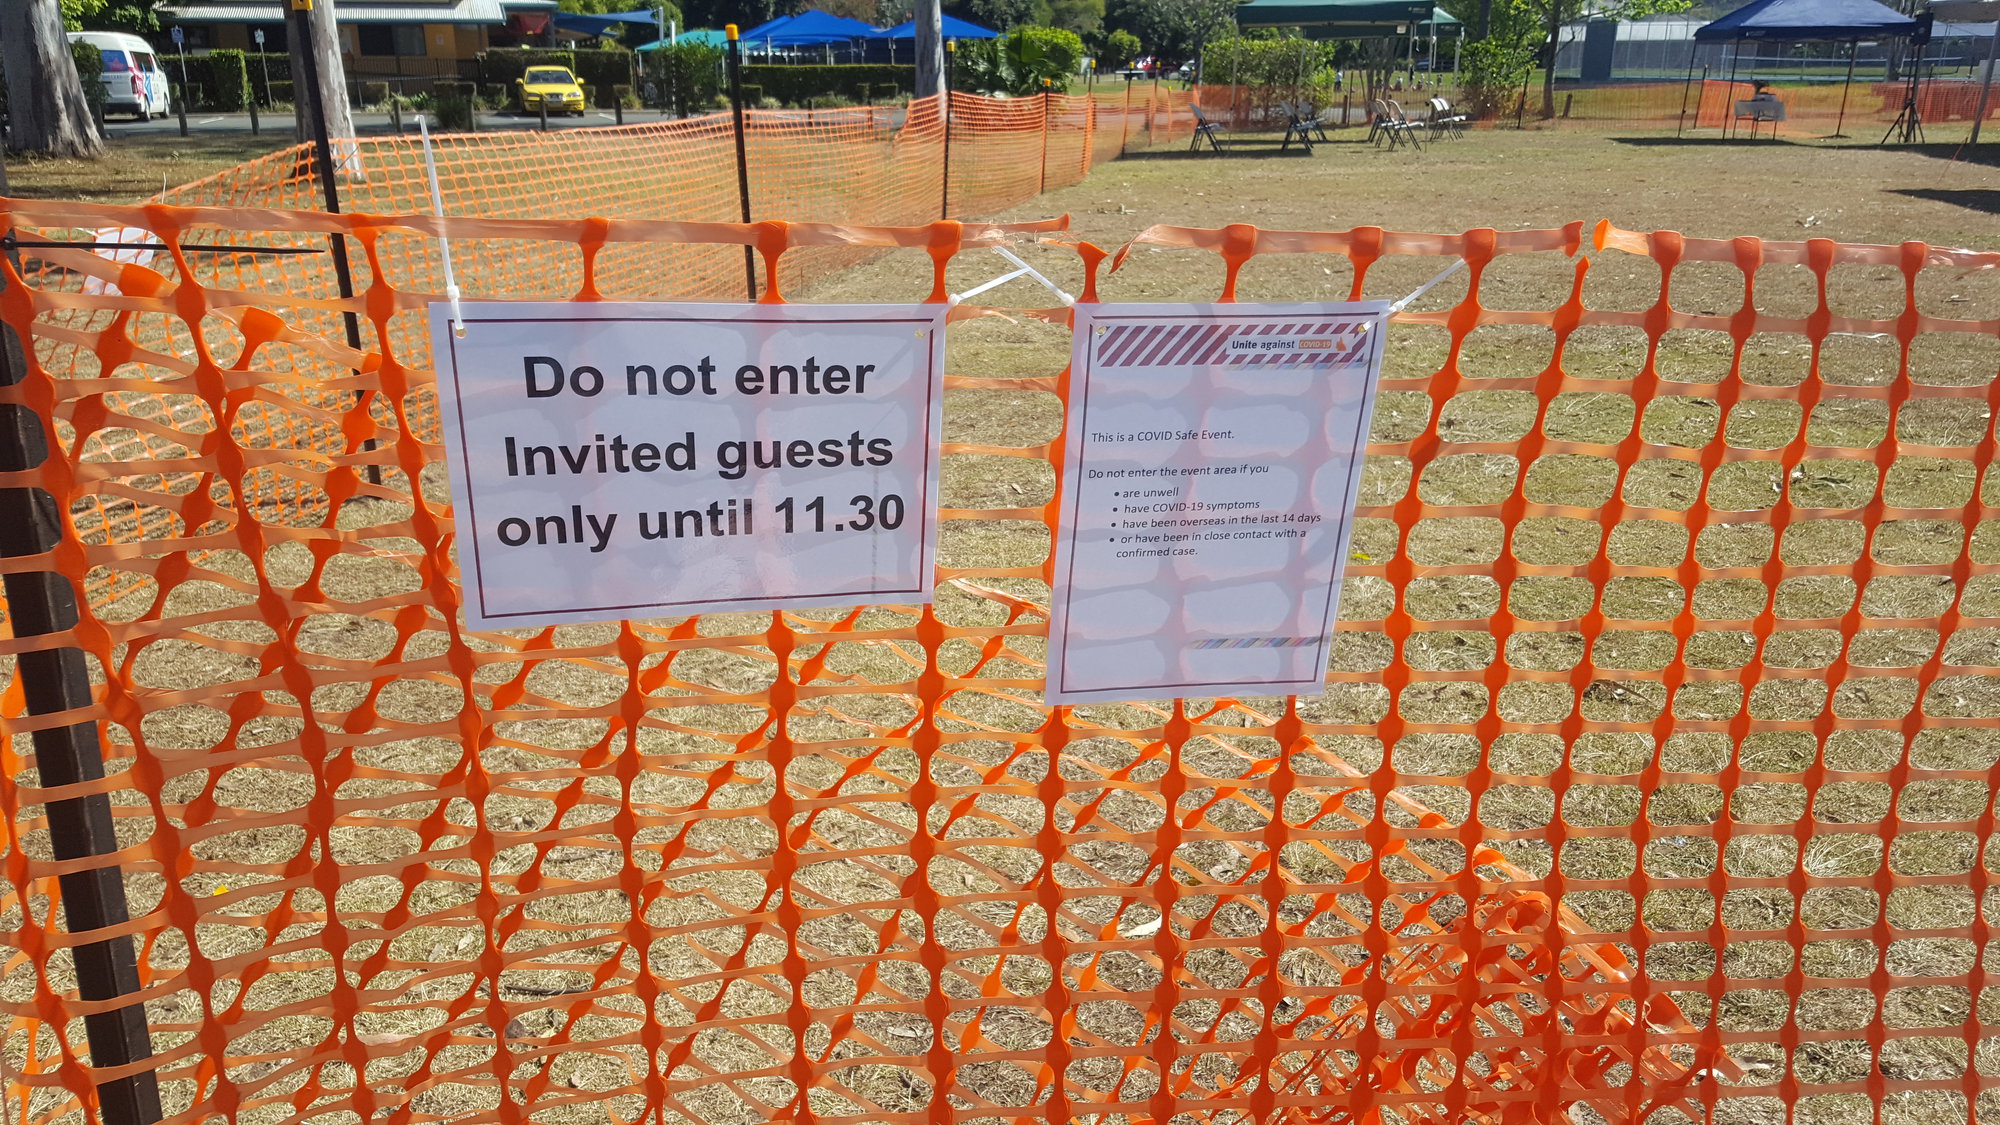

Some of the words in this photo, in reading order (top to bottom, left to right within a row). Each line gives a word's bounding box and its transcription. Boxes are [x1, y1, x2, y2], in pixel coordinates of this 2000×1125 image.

[1232, 340, 1257, 349] Unite
[1260, 339, 1295, 350] against
[1299, 340, 1331, 348] COVID-19
[523, 356, 604, 399] Do
[626, 355, 717, 396] not
[735, 355, 875, 395] enter
[1091, 432, 1114, 443] This
[1116, 432, 1125, 442] is
[1127, 434, 1134, 442] a
[1137, 431, 1173, 442] COVID
[1175, 430, 1199, 441] Safe
[1201, 429, 1234, 440] Event.
[504, 432, 697, 477] Invited
[716, 430, 893, 480] guests
[1088, 469, 1104, 479] Do
[1106, 468, 1125, 478] not
[1127, 468, 1157, 478] enter
[1160, 466, 1178, 477] the
[1180, 466, 1210, 476] event
[1213, 466, 1237, 475] area
[1239, 463, 1249, 474] if
[1249, 464, 1269, 476] you
[1122, 490, 1140, 499] are
[1143, 487, 1179, 498] unwell
[1124, 503, 1150, 514] have
[1152, 501, 1204, 513] COVID-19
[1206, 500, 1260, 512] symptoms
[496, 505, 618, 553] only
[638, 498, 754, 540] until
[775, 494, 904, 534] 11.30
[1122, 518, 1148, 529] have
[1150, 517, 1177, 528] been
[1179, 516, 1225, 527] overseas
[1228, 515, 1238, 525] in
[1240, 514, 1258, 524] the
[1260, 513, 1279, 524] last
[1282, 513, 1295, 523] 14
[1297, 512, 1321, 524] days
[1120, 536, 1133, 544] or
[1135, 533, 1160, 544] have
[1163, 532, 1189, 543] been
[1191, 531, 1201, 542] in
[1204, 530, 1230, 541] close
[1233, 529, 1271, 540] contact
[1274, 528, 1297, 539] with
[1299, 530, 1306, 538] a
[1116, 547, 1170, 558] confirmed
[1172, 546, 1198, 556] case.
